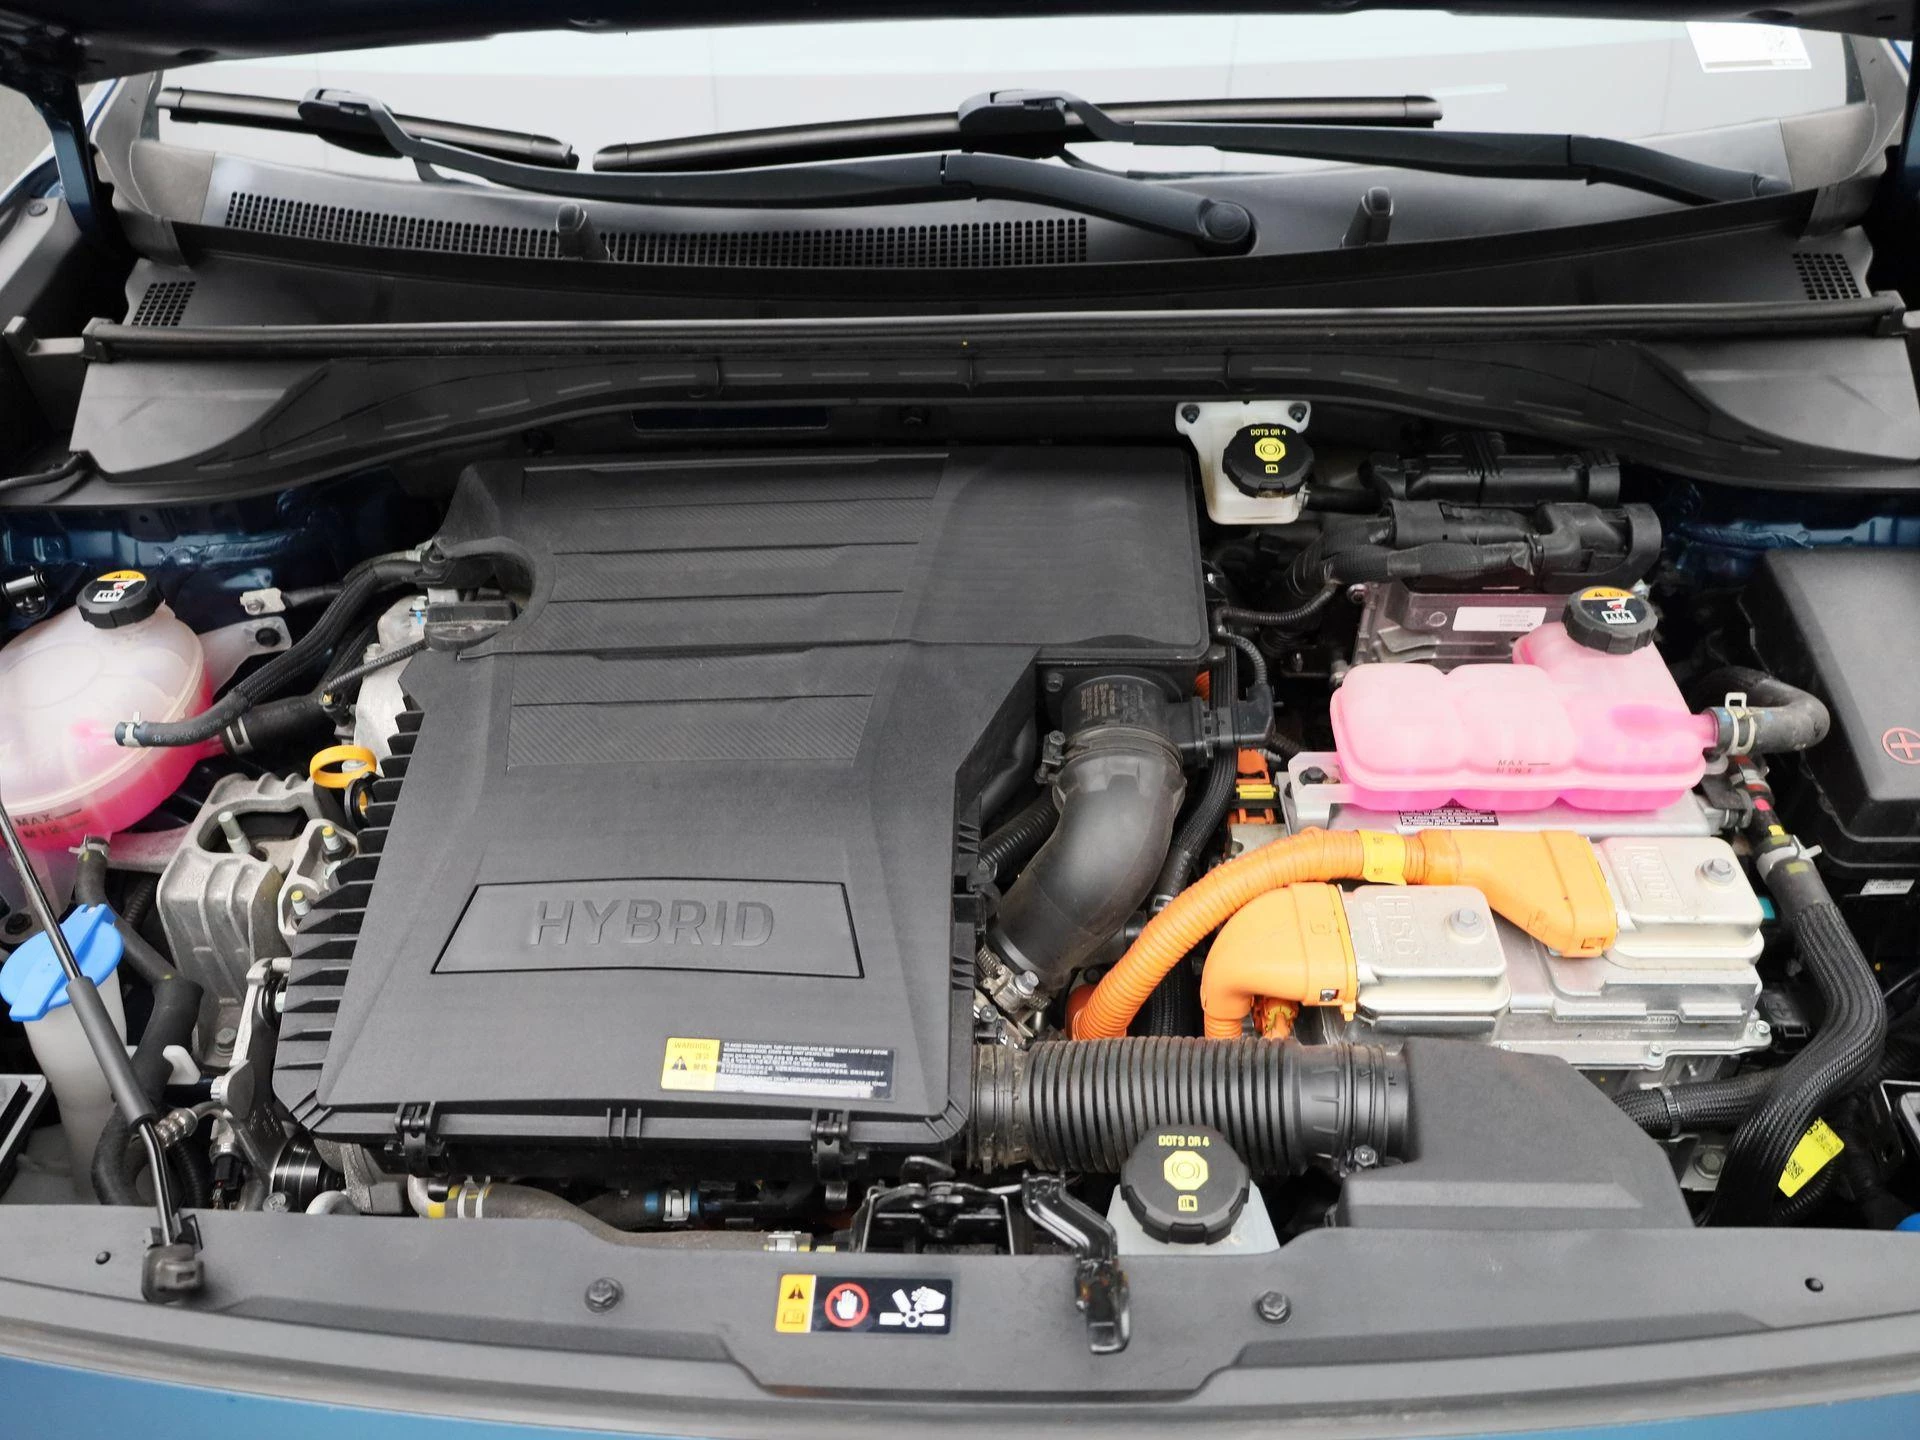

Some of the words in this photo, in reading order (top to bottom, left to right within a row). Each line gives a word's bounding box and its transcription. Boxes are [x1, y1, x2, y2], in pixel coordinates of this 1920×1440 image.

[1250, 428, 1269, 436] DOT3
[1270, 428, 1280, 436] OR
[1497, 759, 1524, 767] MAX
[14, 813, 53, 827] MAX
[529, 899, 774, 947] HYBRID
[1158, 1134, 1185, 1147] DOT3
[1187, 1135, 1201, 1147] OR
[1202, 1136, 1210, 1147] 4
